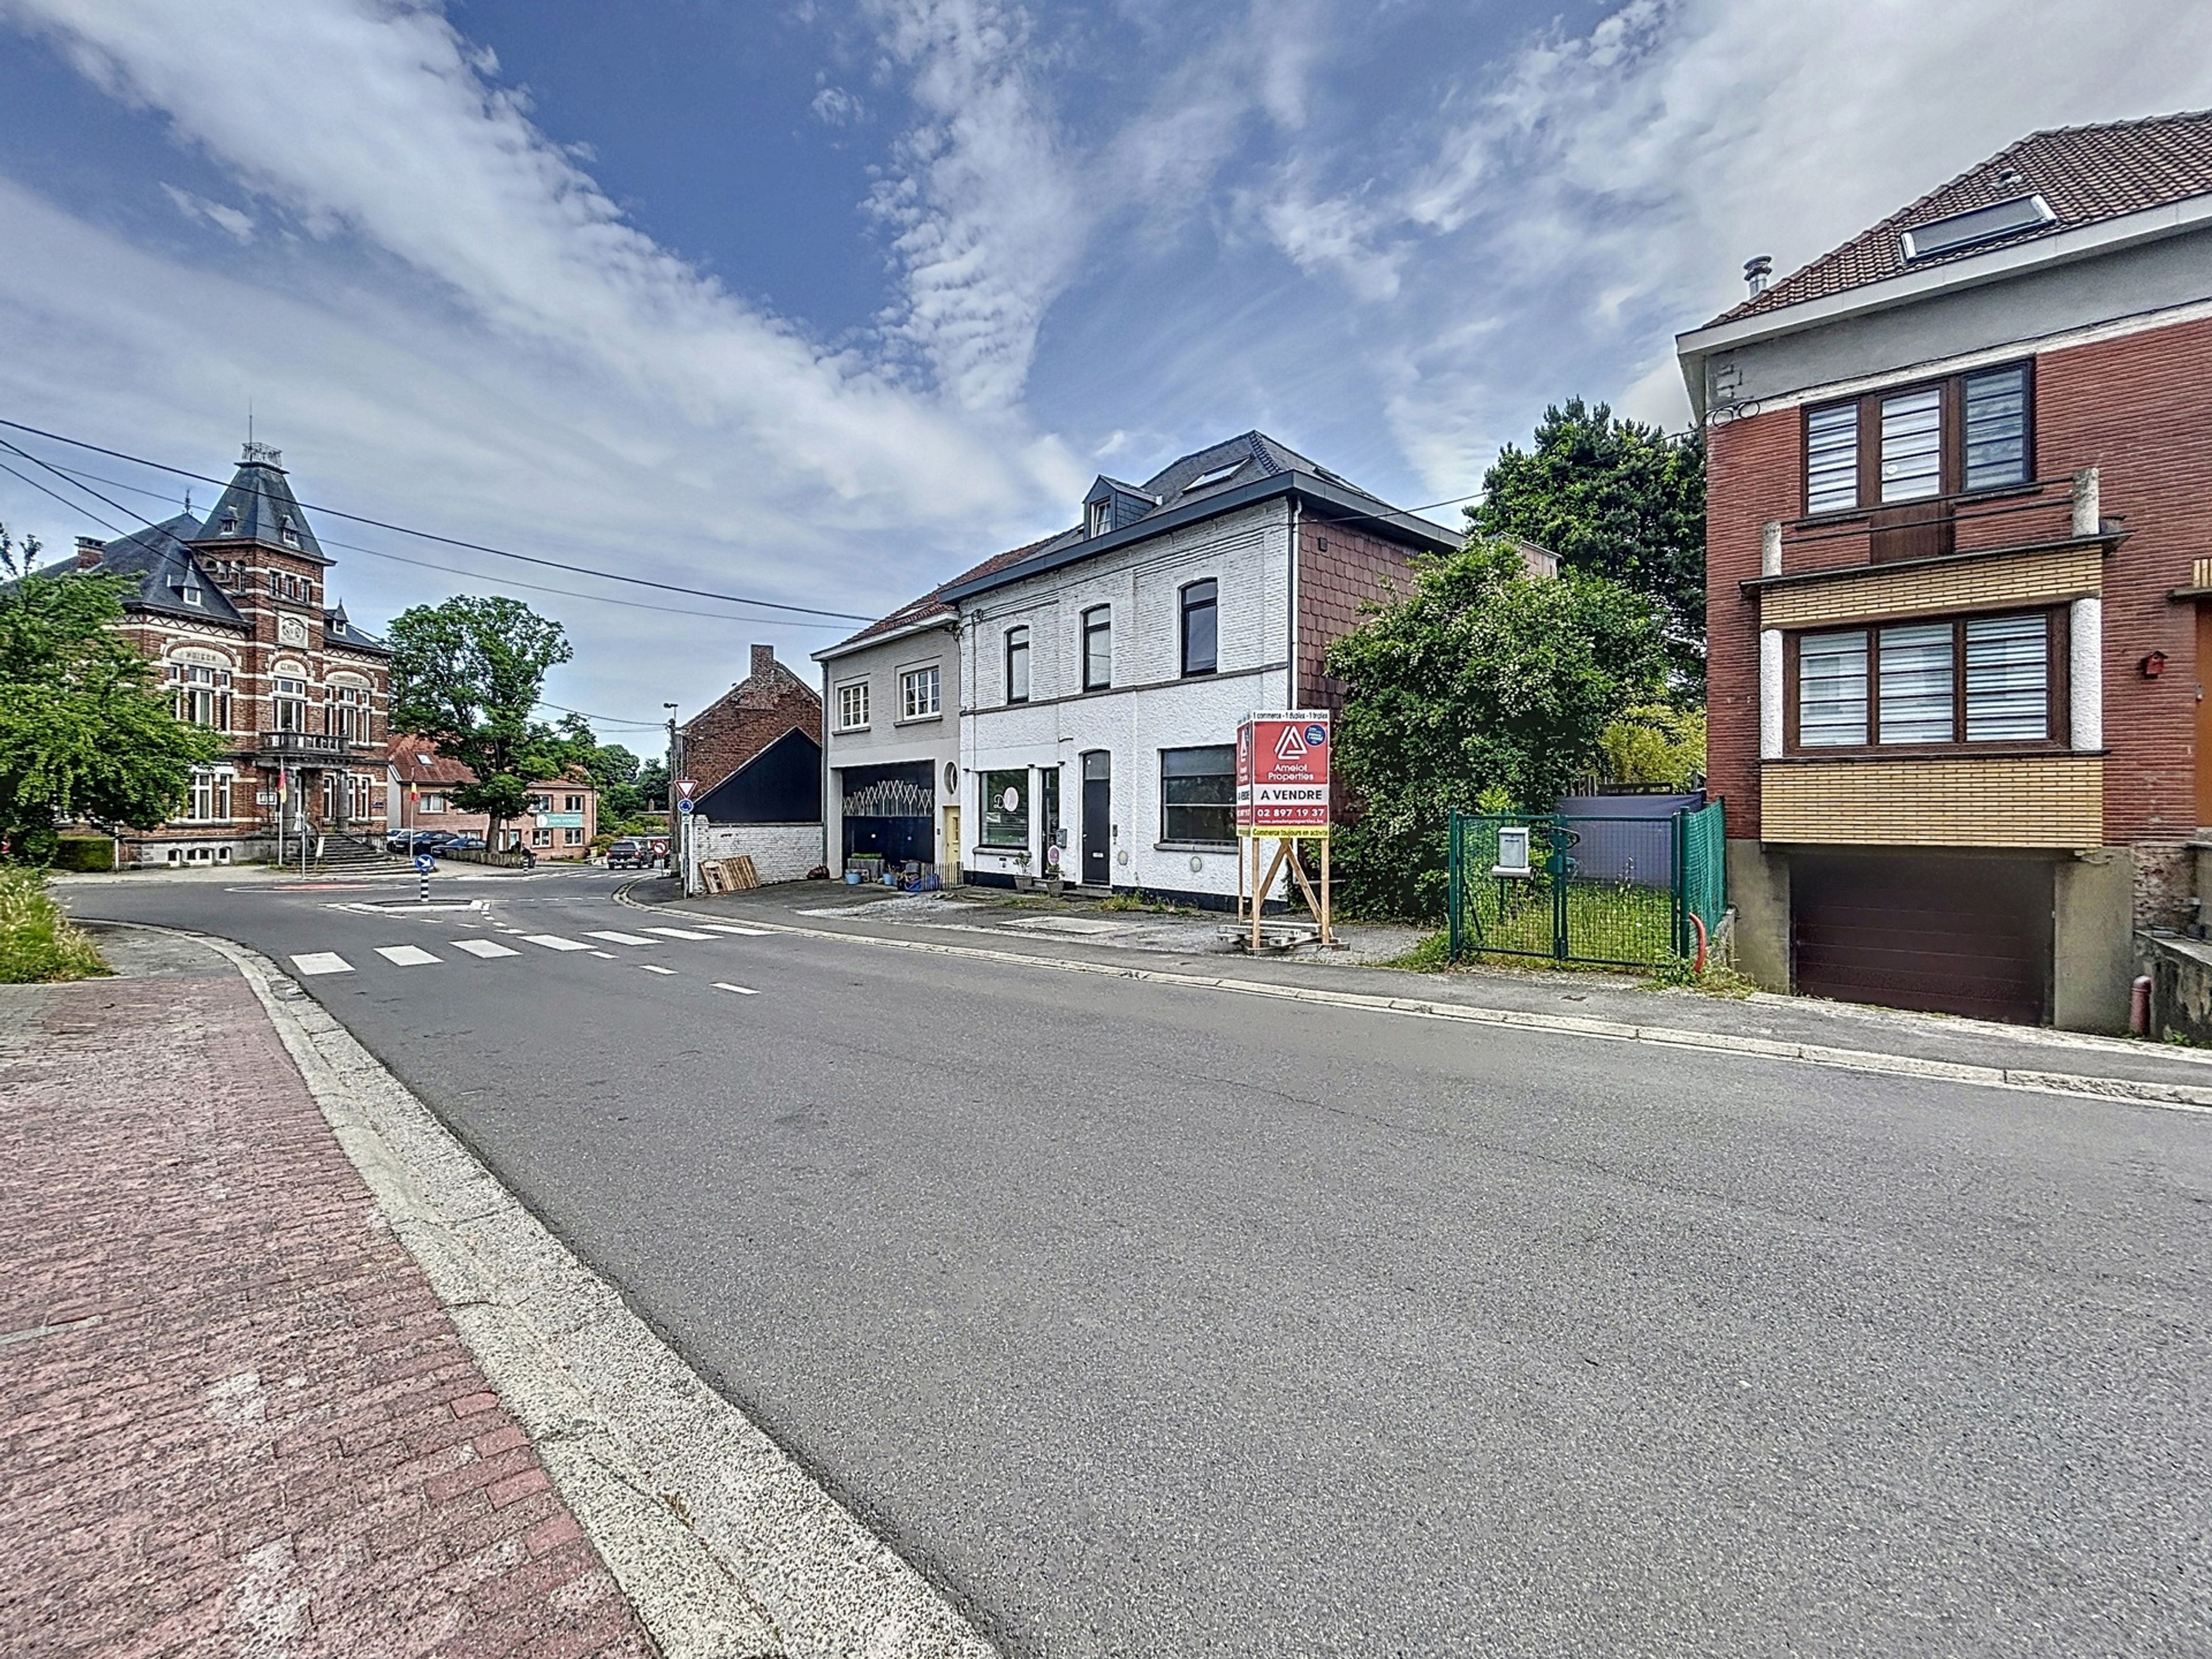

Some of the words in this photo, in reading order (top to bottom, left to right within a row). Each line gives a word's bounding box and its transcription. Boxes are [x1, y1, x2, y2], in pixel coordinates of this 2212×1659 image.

[1268, 772, 1314, 782] Properties
[1260, 790, 1270, 800] A
[1273, 790, 1322, 800] VENDRE
[1257, 809, 1270, 817] 02
[1274, 809, 1293, 817] 897
[1296, 809, 1309, 817] 19
[1312, 809, 1325, 817] 37
